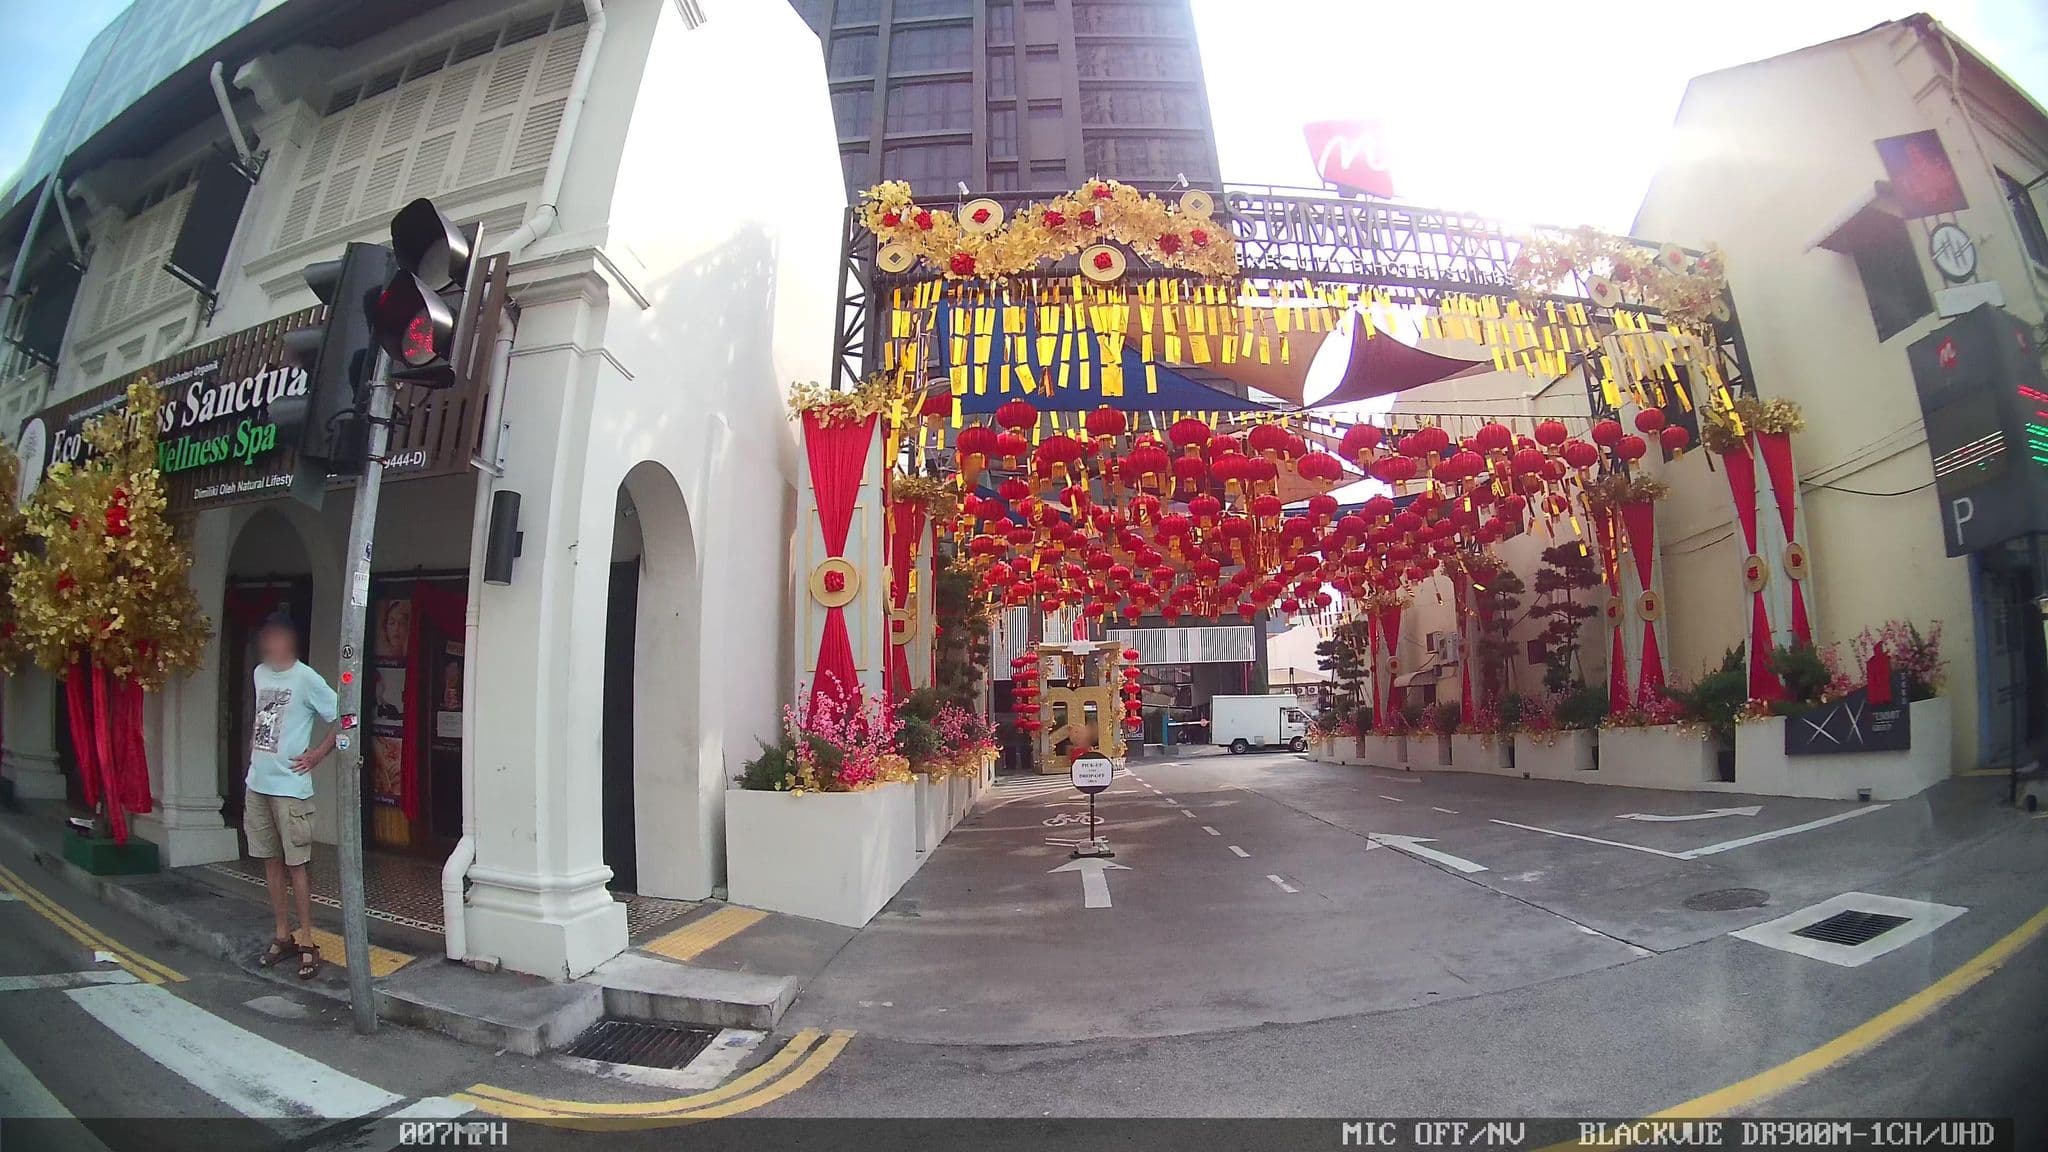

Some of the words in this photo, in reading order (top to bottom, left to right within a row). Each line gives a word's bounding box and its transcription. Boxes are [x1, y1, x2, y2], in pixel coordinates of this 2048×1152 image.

[51, 428, 82, 469] Eco
[233, 418, 276, 466] Spa
[219, 481, 236, 495] Oleh
[237, 476, 265, 493] Natural
[1952, 497, 1974, 545] P
